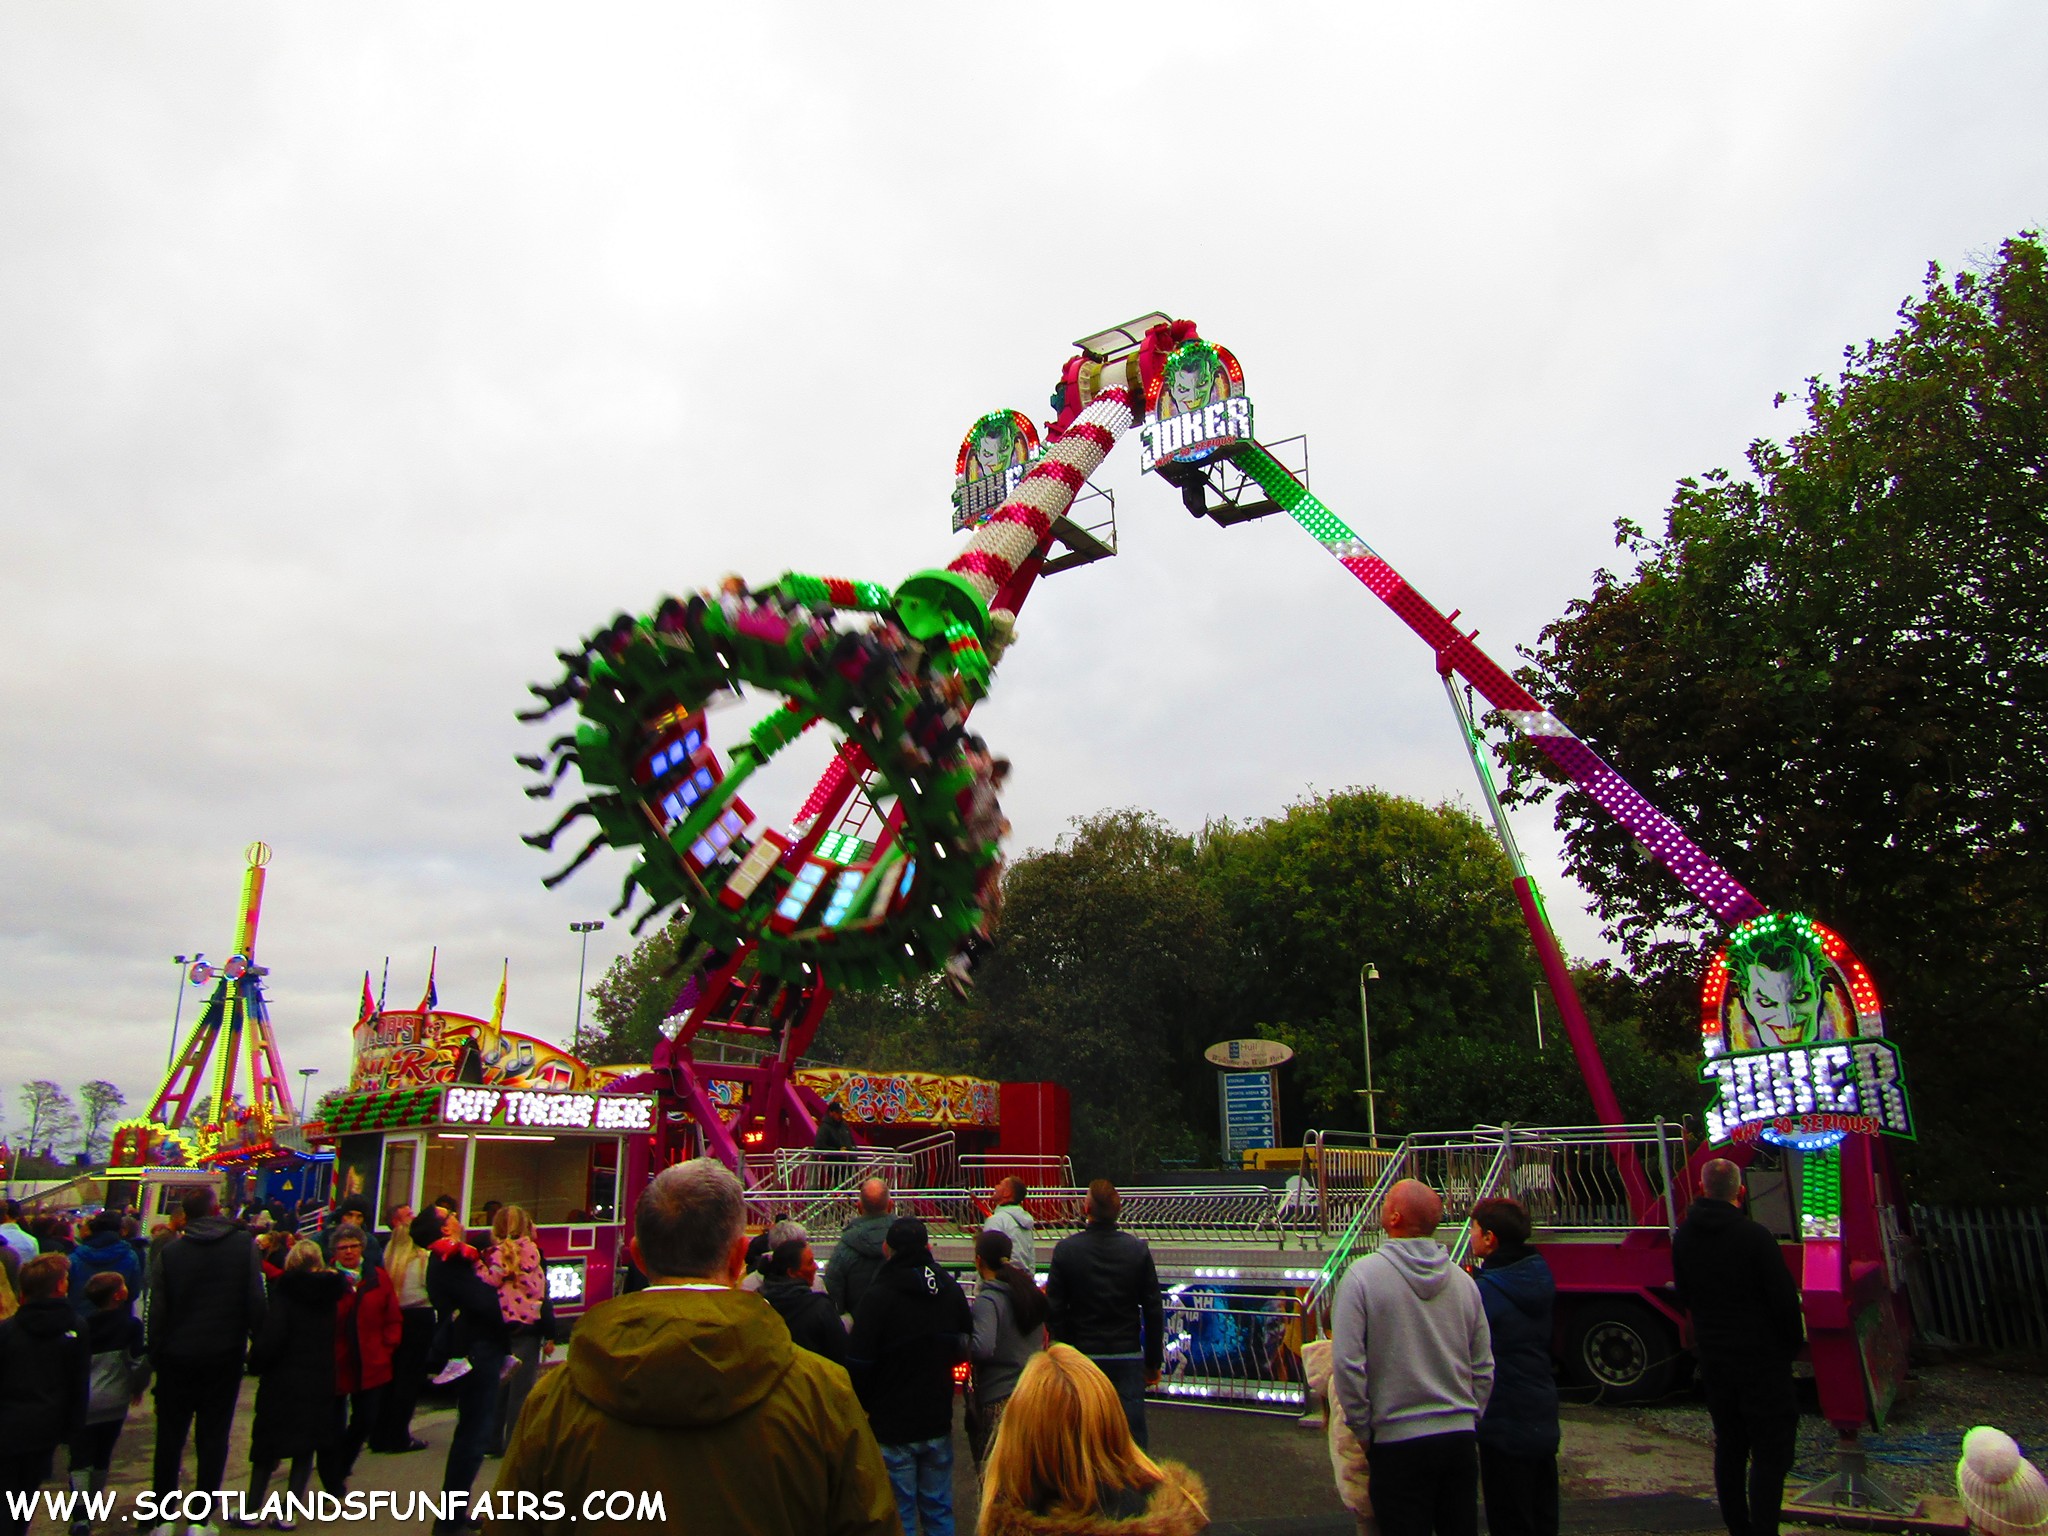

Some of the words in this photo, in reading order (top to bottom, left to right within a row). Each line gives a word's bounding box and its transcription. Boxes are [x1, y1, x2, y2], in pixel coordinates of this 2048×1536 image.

[1142, 397, 1250, 471] JOKER
[1154, 452, 1175, 468] WHY
[1179, 447, 1191, 457] SO
[1194, 436, 1236, 452] SERIOUS!
[953, 461, 1037, 529] JOKE
[447, 1088, 500, 1122] BUY
[597, 1097, 653, 1129] HERE
[1703, 1043, 1908, 1143] JOKER
[1731, 1119, 1763, 1144] WHY
[1773, 1117, 1793, 1136] SO
[1800, 1114, 1880, 1136] SERIOUS!
